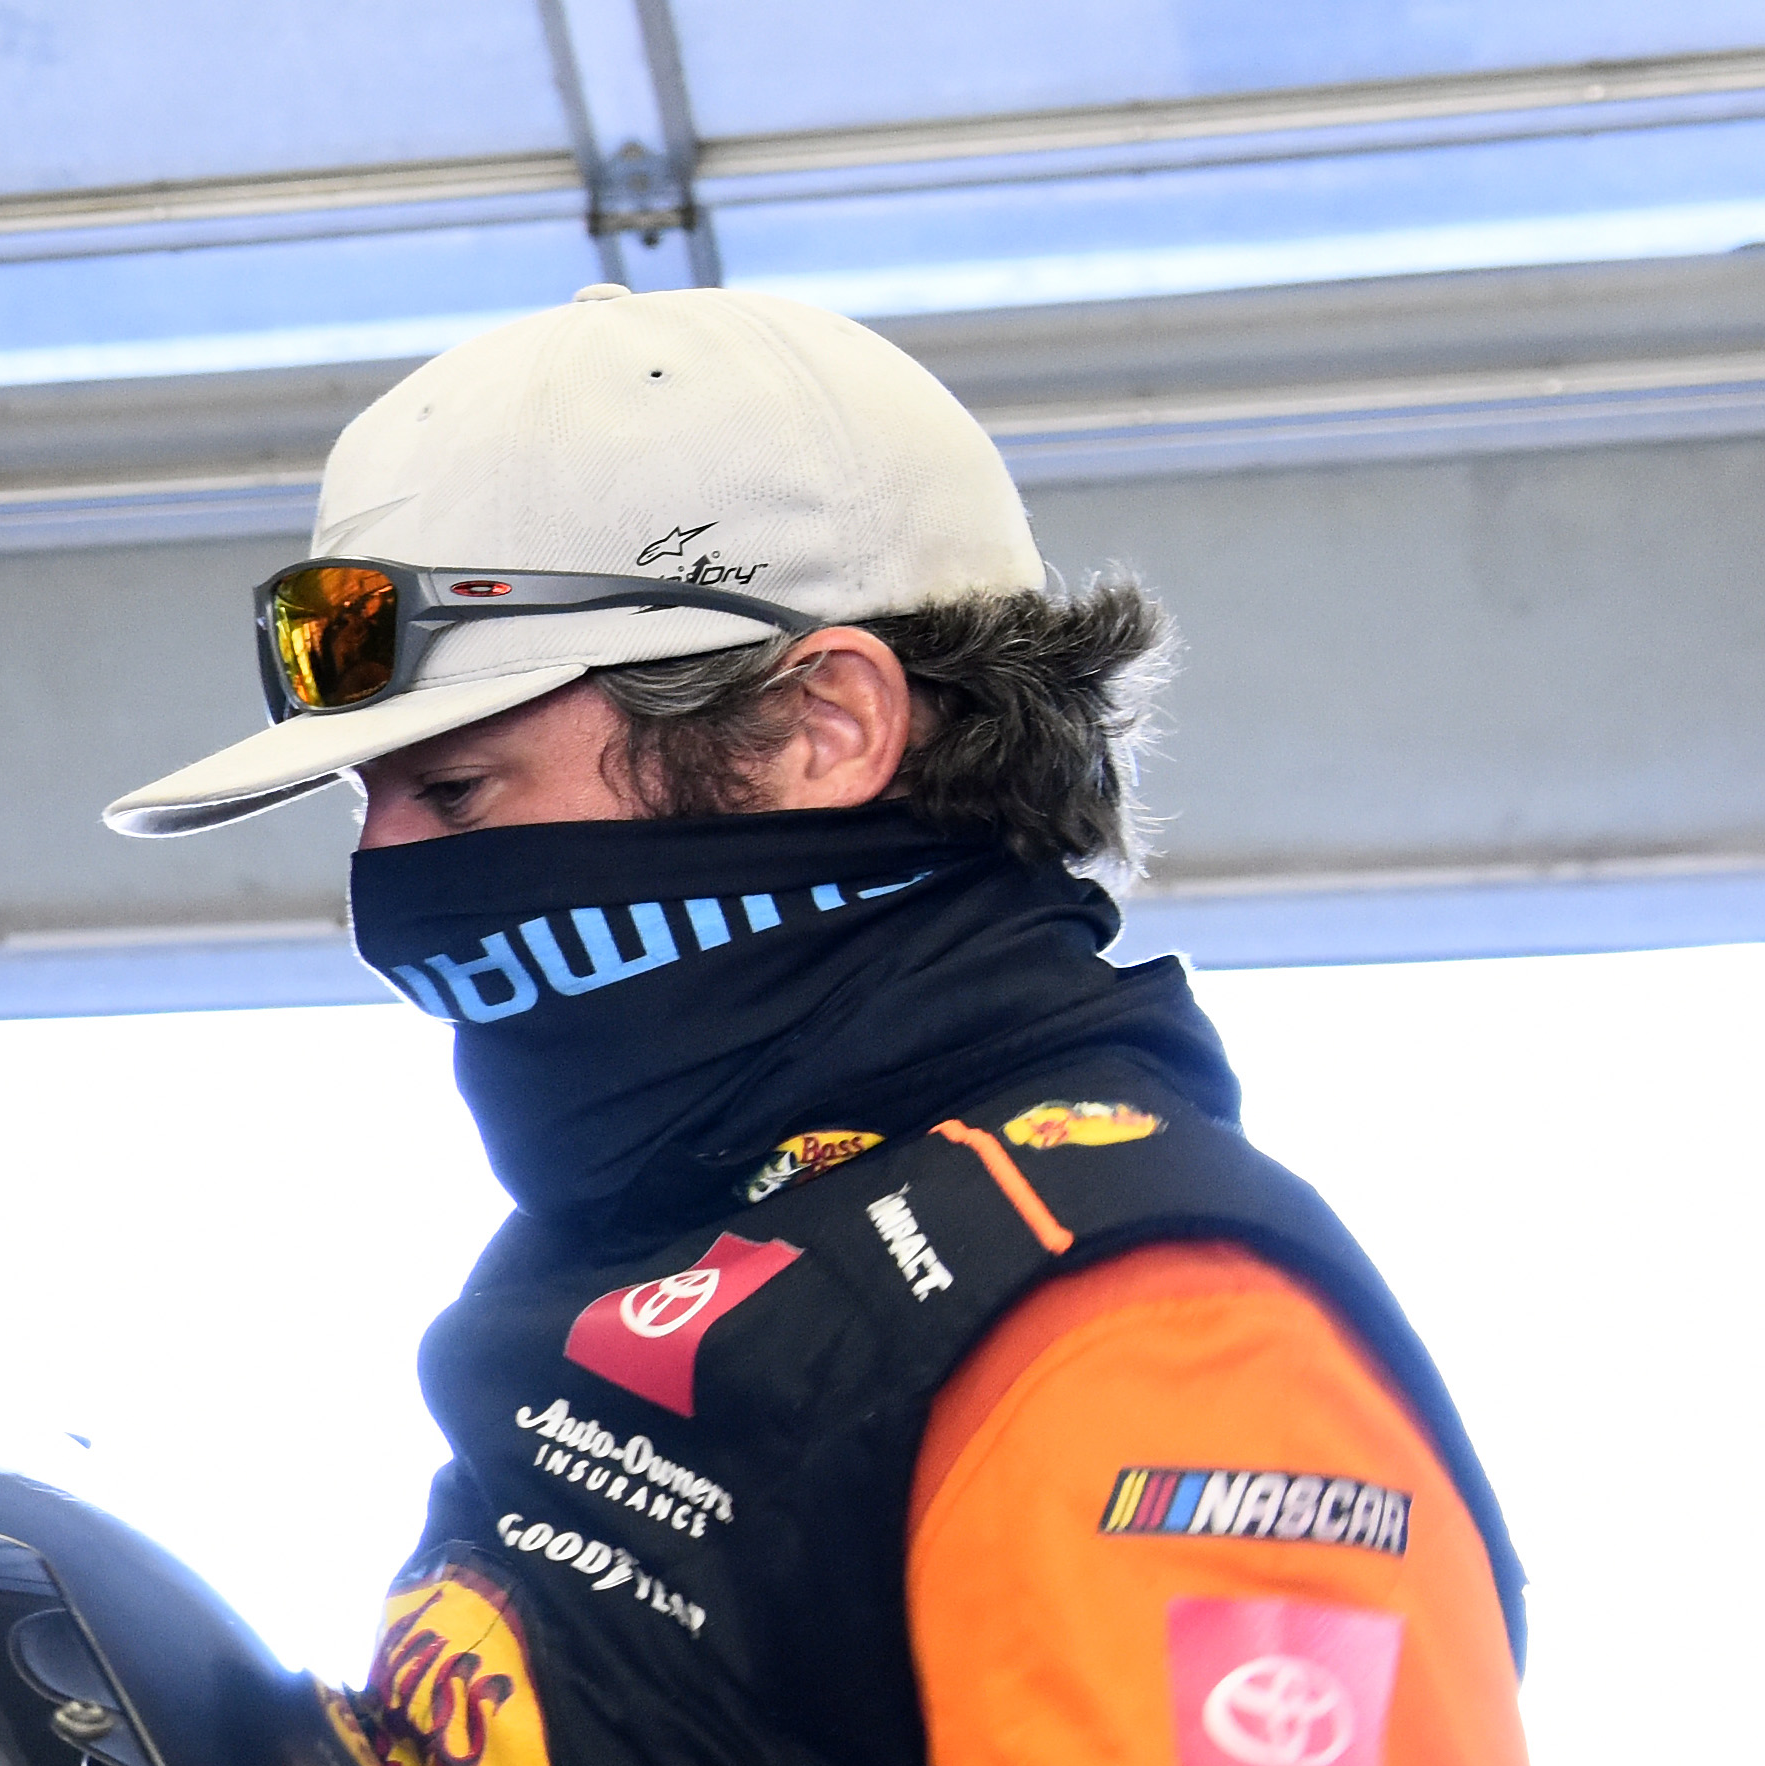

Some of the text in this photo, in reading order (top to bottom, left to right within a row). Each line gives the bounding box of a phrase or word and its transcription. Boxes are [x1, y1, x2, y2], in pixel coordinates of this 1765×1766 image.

[801, 1136, 865, 1165] Bass
[515, 1398, 733, 1524] Auto-Owners
[533, 1443, 708, 1538] INSURANCE
[1187, 1469, 1406, 1556] NASCAR
